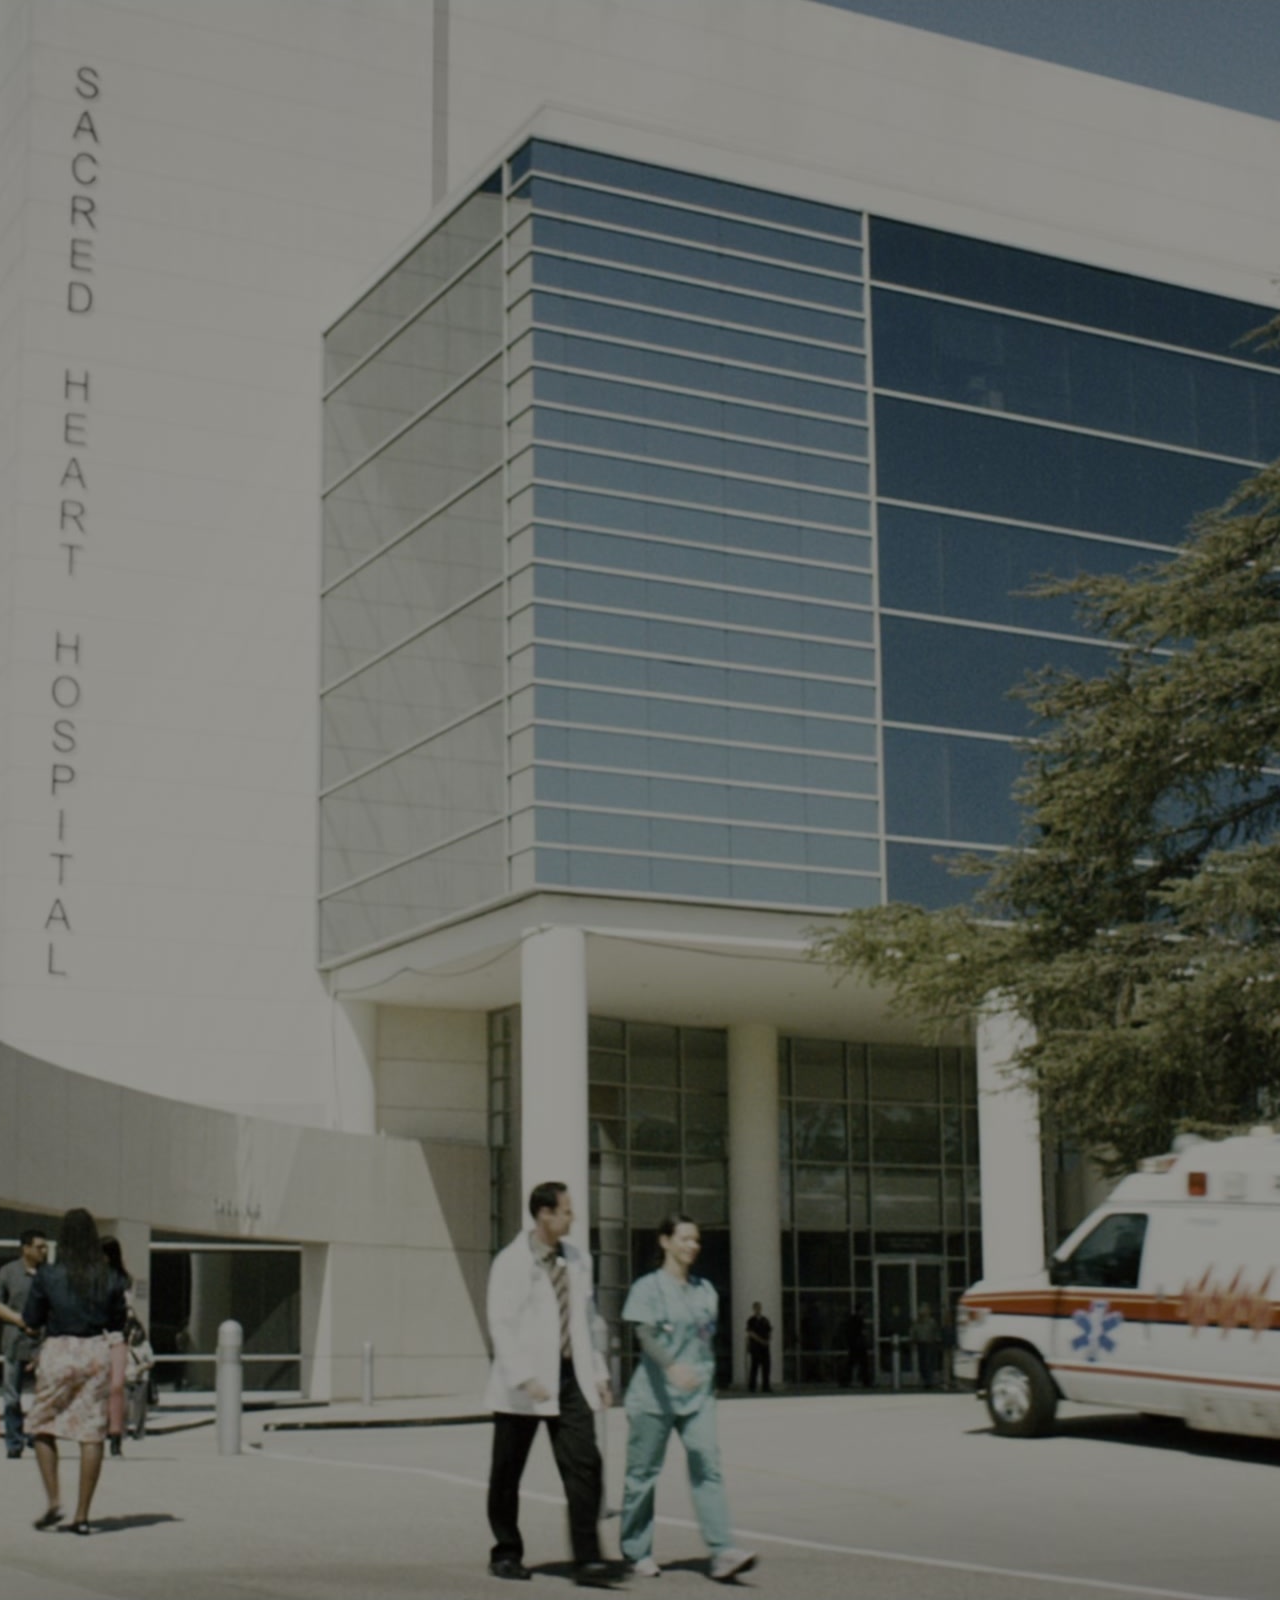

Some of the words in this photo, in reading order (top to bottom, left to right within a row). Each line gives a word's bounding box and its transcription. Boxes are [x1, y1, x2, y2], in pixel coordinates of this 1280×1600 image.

[66, 66, 101, 315] SACRED
[59, 368, 91, 577] HEART
[44, 630, 82, 977] HOSPITAL
